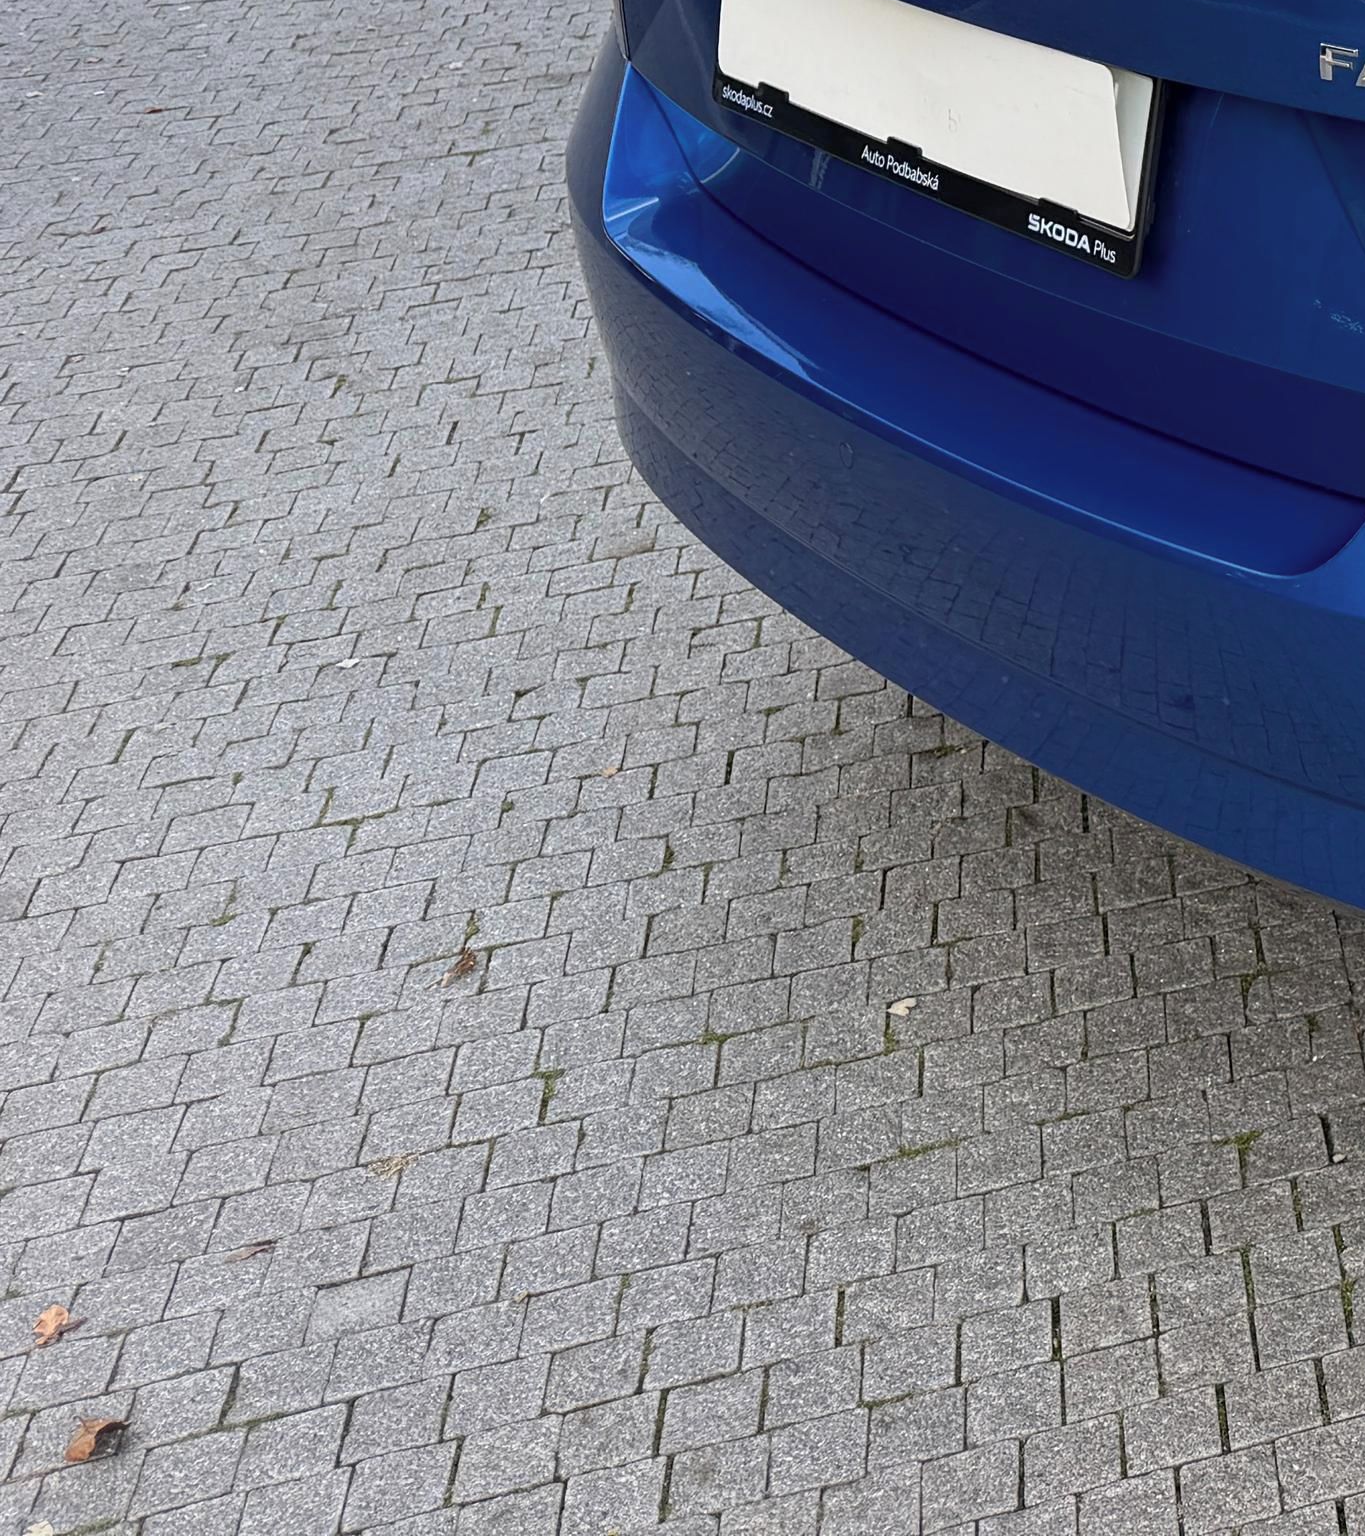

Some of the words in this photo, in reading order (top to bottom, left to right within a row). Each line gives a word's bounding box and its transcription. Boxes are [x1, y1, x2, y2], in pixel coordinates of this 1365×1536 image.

[721, 84, 774, 118] skodaplus.cz
[860, 144, 886, 168] Auto
[886, 154, 940, 191] Podbabská
[1093, 239, 1117, 264] Plus
